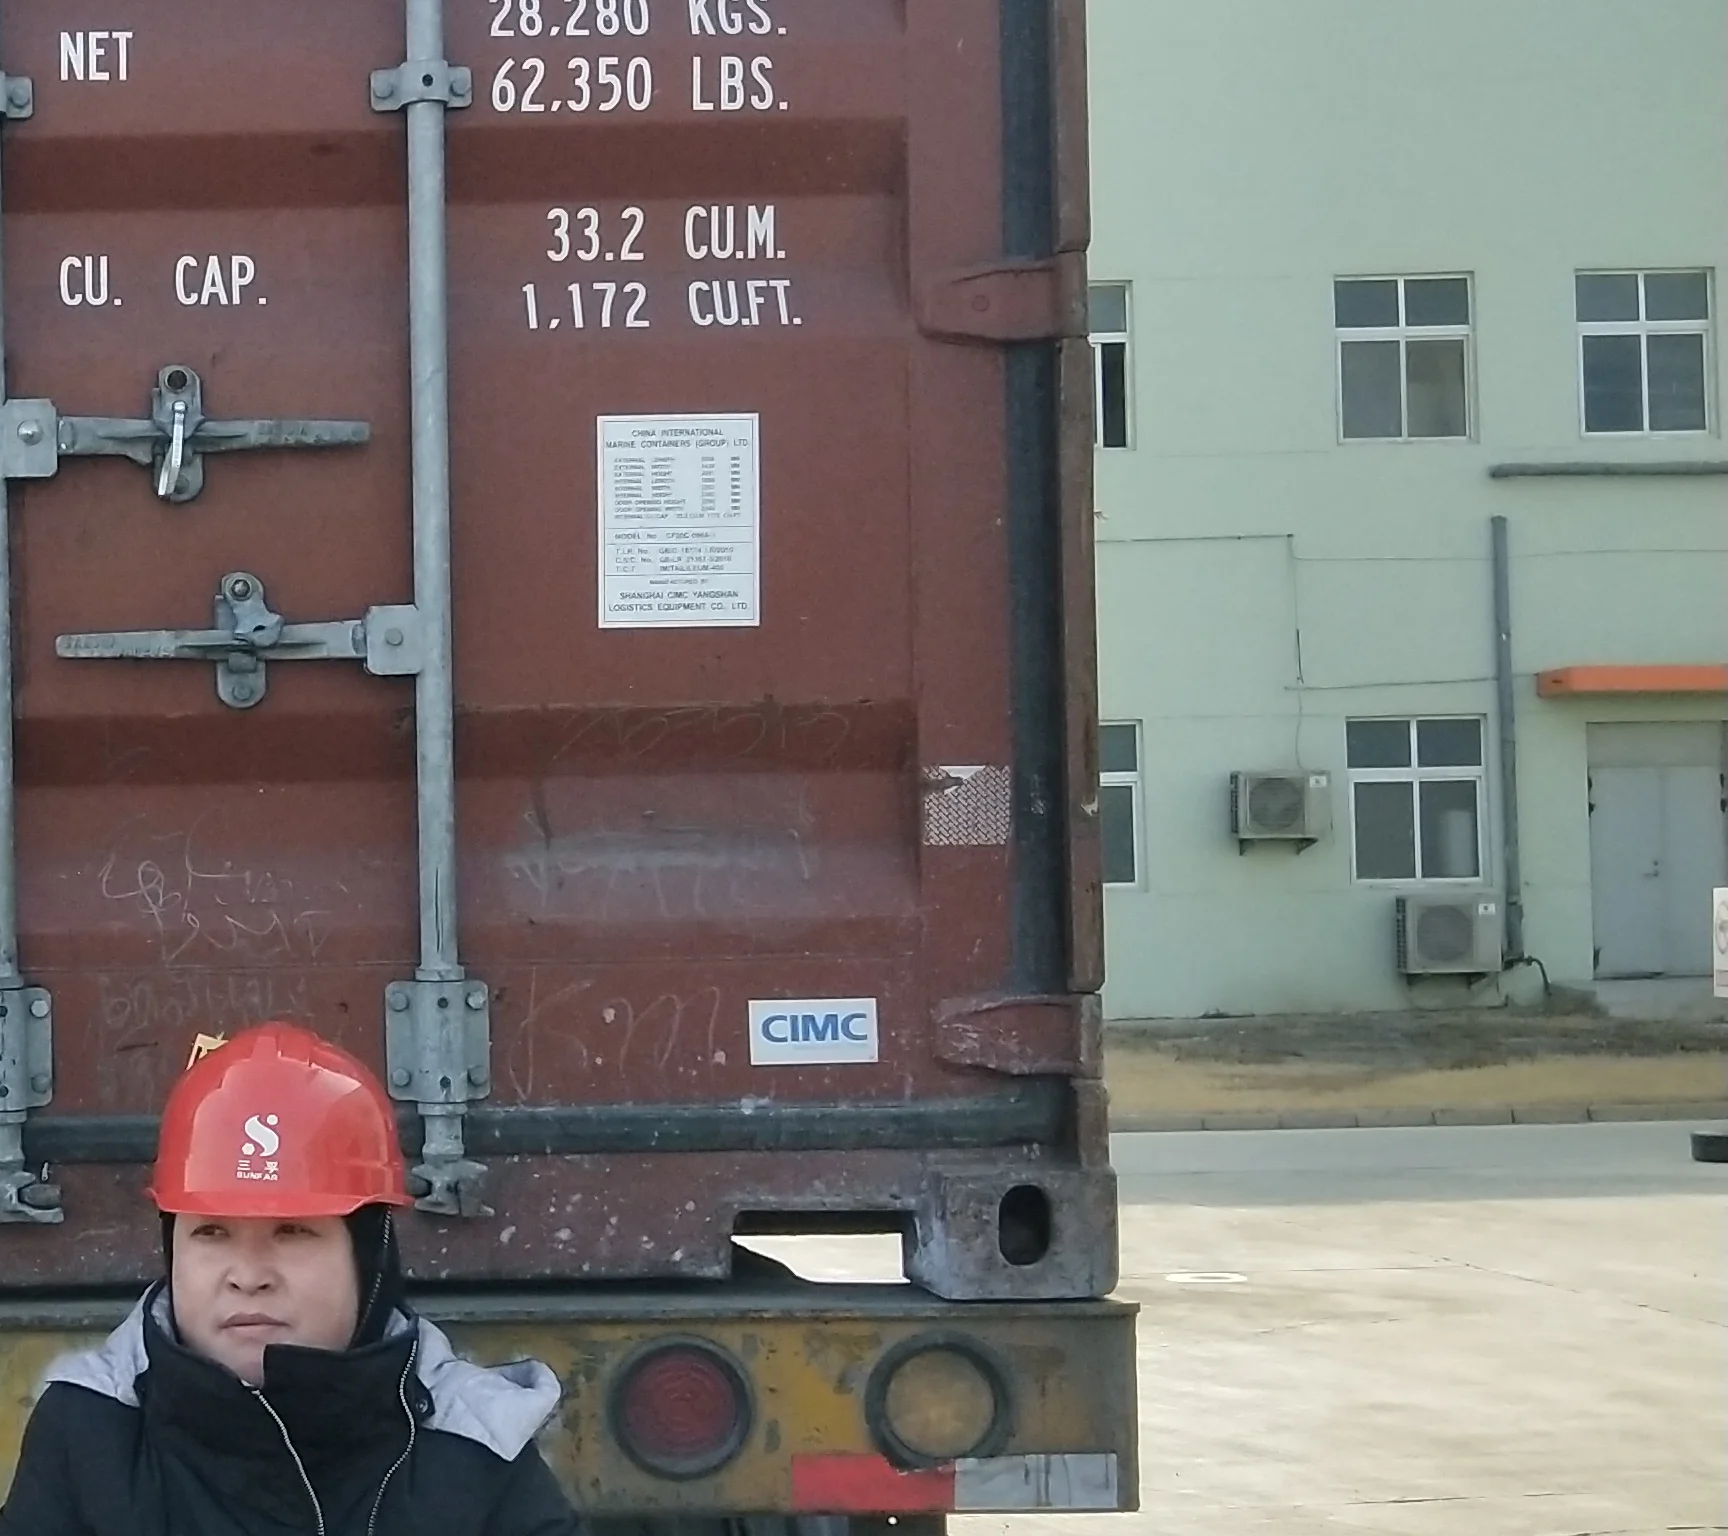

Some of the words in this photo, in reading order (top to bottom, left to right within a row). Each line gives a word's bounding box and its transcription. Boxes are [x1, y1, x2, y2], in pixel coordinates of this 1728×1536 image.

[60, 31, 133, 81] NET
[491, 56, 652, 112] 62,350
[692, 56, 788, 111] LBS.
[546, 206, 644, 262] 33.2
[684, 204, 786, 260] CU.M.
[59, 255, 122, 306] CU.
[175, 255, 267, 305] CAP.
[522, 282, 650, 329] 1,172
[688, 279, 802, 326] CU.FT.
[641, 440, 691, 448] CONTAINERS
[661, 428, 724, 437] INTERNATIONAL
[608, 603, 653, 612] LOGISTICS
[657, 602, 706, 611] EQUIPMENT
[761, 1012, 868, 1043] CIMC
